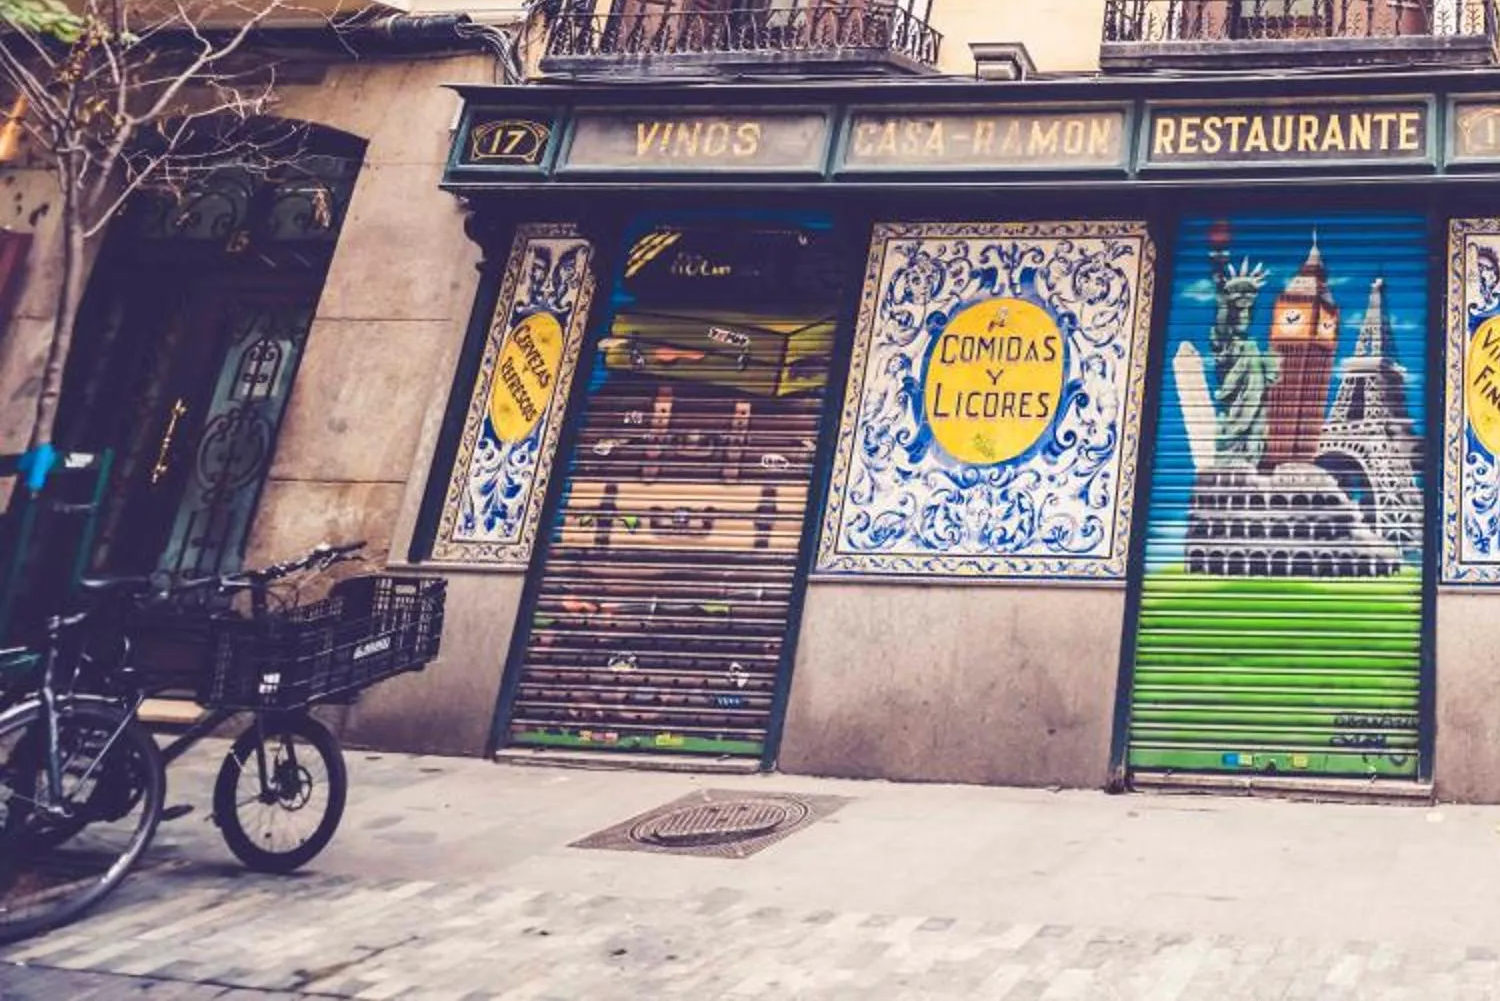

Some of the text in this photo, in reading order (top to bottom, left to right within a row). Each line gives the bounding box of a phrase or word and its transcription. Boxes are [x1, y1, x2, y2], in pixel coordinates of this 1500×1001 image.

[489, 129, 527, 155] 17
[635, 121, 761, 158] VINOS
[1153, 112, 1420, 155] RESTAURANTE
[513, 324, 551, 389] CERVEZAS
[940, 334, 1057, 364] COMIDAS
[502, 356, 537, 422] REFRESCOS
[986, 369, 1004, 385] Y
[933, 383, 1050, 418] LICORES
